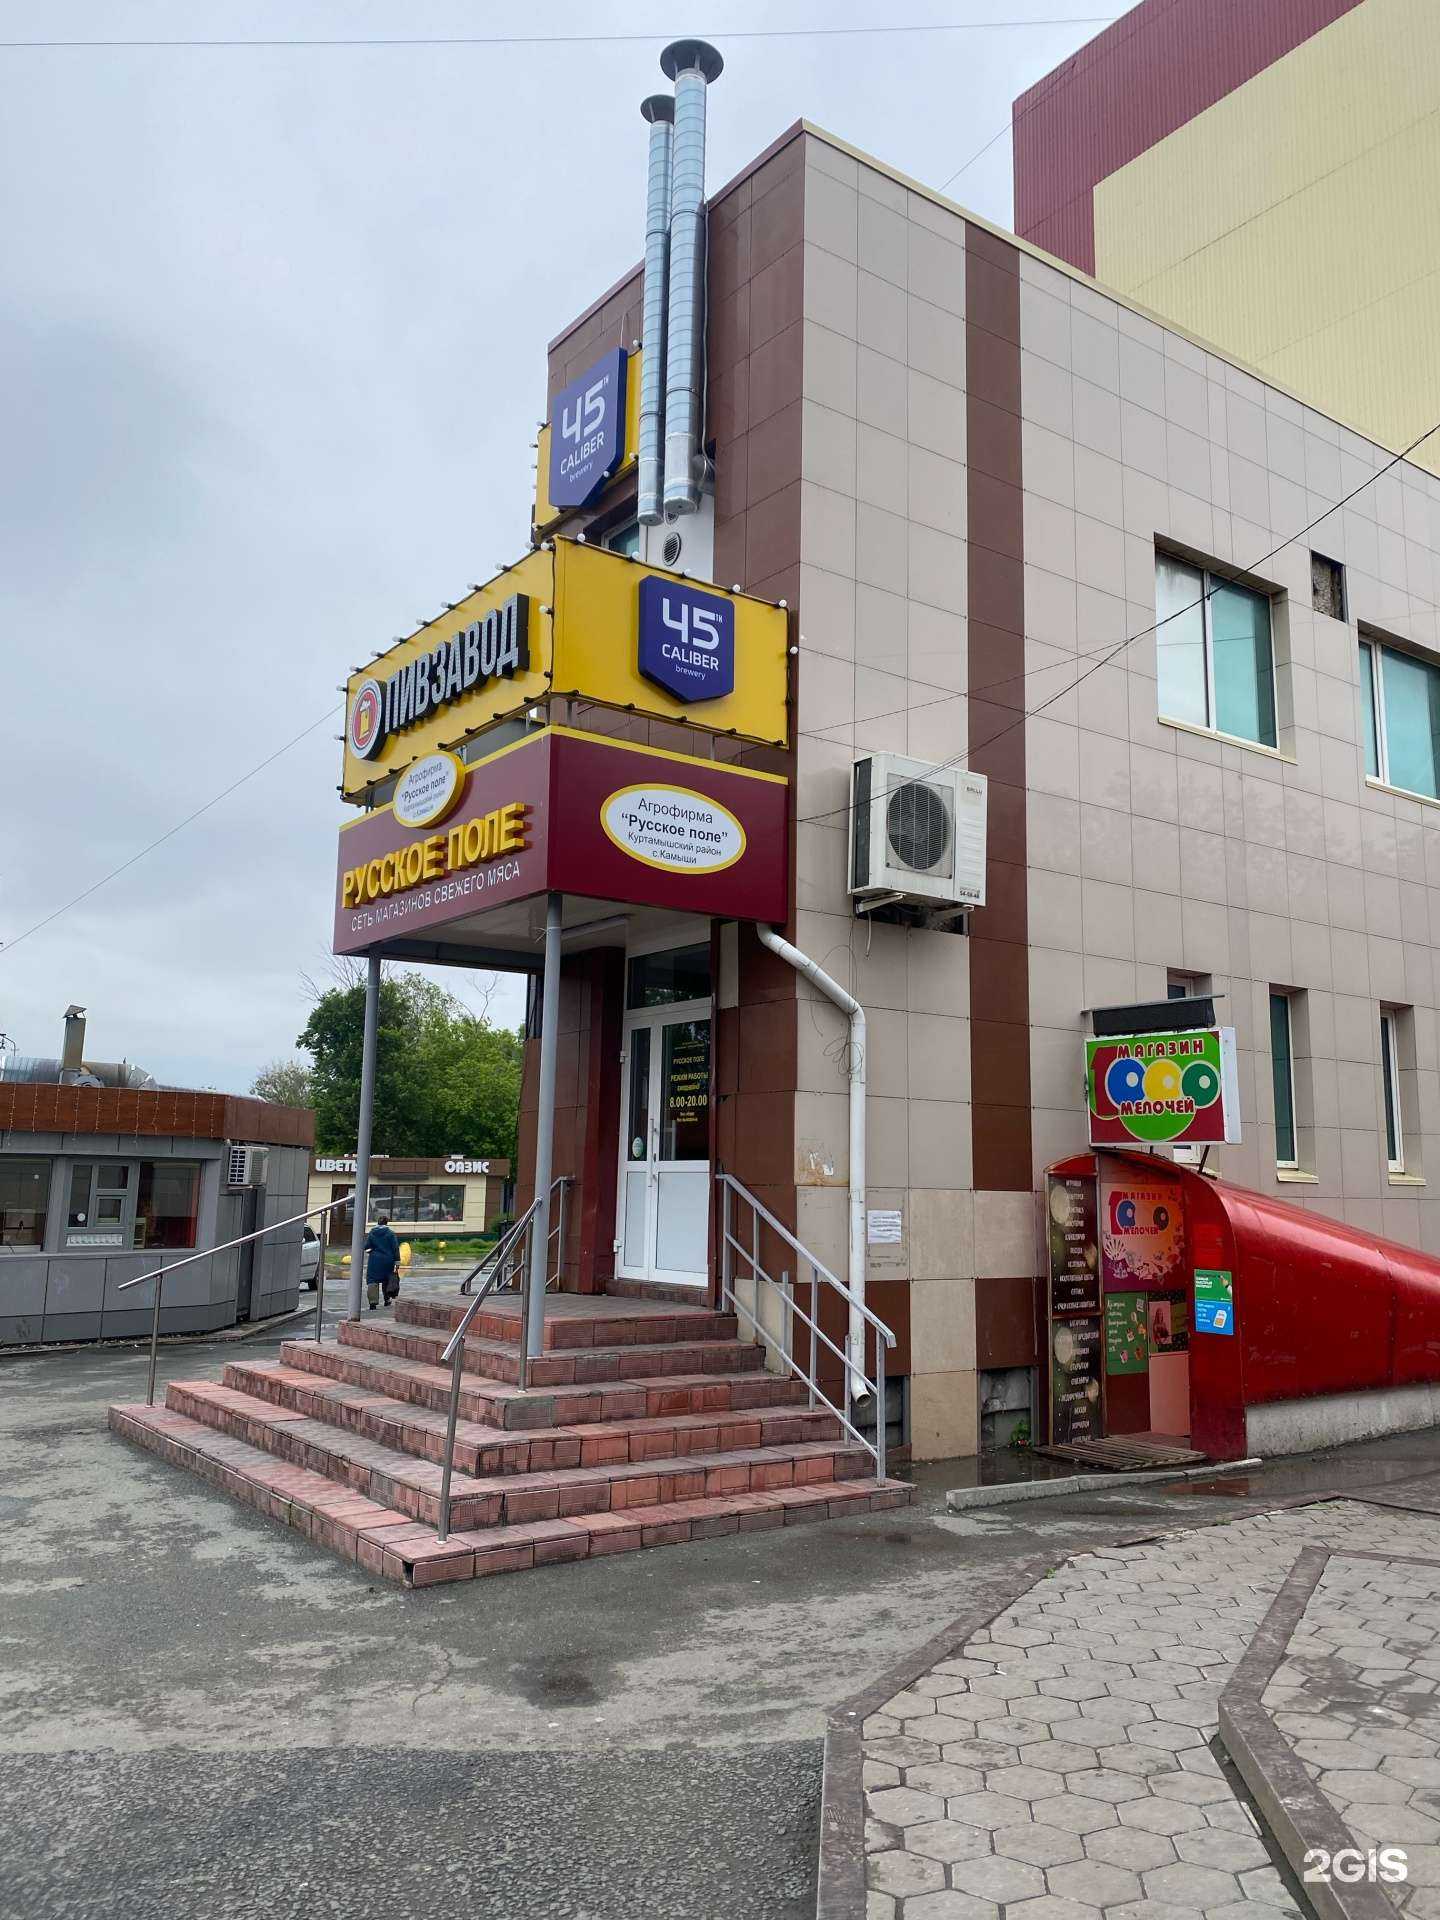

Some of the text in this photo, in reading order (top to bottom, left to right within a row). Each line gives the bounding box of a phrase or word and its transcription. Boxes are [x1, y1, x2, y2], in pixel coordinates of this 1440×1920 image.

[562, 378, 607, 444] 45
[560, 431, 604, 475] CALIBER
[385, 592, 520, 734] ПИВЗАВОД
[662, 643, 719, 671] CALIBER
[675, 664, 706, 680] brewery
[638, 797, 713, 824] Агрофирма
[342, 802, 525, 909] РУССКОЕ ПОЛЕ
[628, 832, 722, 857] Куртамышский район
[652, 849, 697, 864] с.Камыши
[351, 860, 520, 932] СЕТЬ МАГАЗИНОВ СВЕЖЕГО МЯСА
[1116, 1038, 1204, 1058] МАГАЗИН
[669, 1094, 708, 1108] 8.00-20.00
[1120, 1097, 1196, 1116] МЕЛОЧЕЙ
[444, 1160, 490, 1173] ОАЗИС
